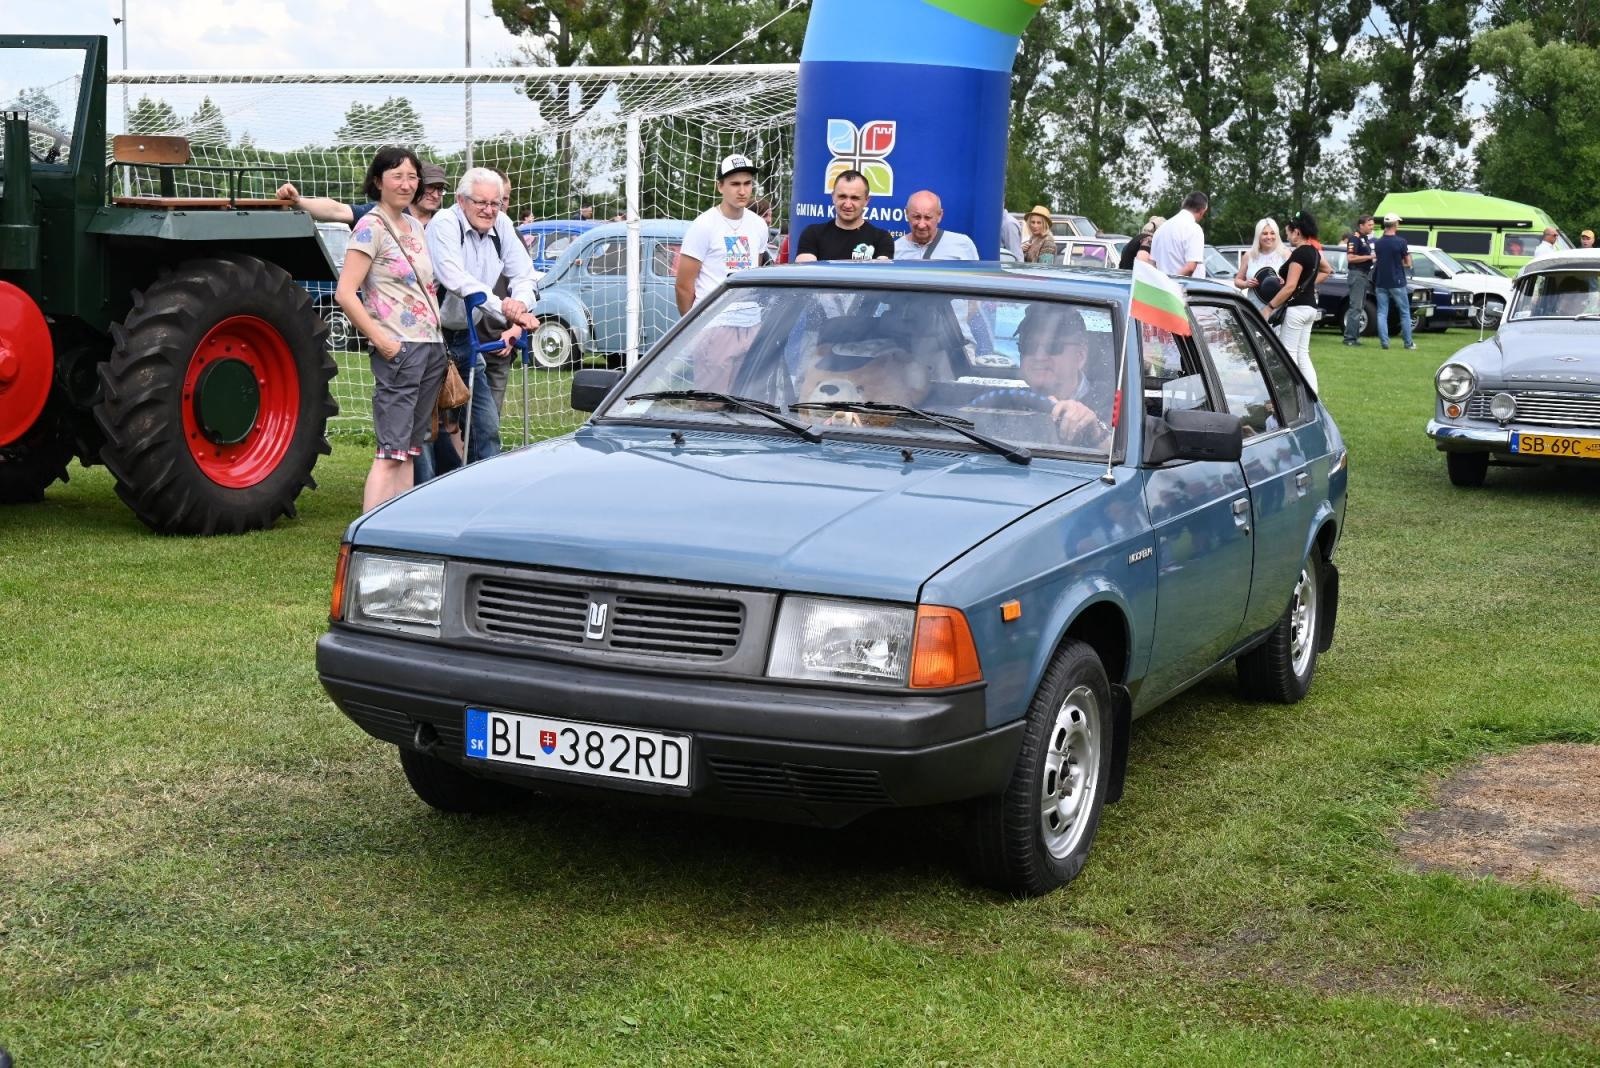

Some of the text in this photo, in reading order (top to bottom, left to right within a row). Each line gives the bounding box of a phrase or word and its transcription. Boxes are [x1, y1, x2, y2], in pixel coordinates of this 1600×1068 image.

[796, 203, 825, 217] GMINA
[1521, 436, 1581, 455] SB 69C
[470, 738, 484, 750] SK
[491, 716, 683, 779] BL 382RD
